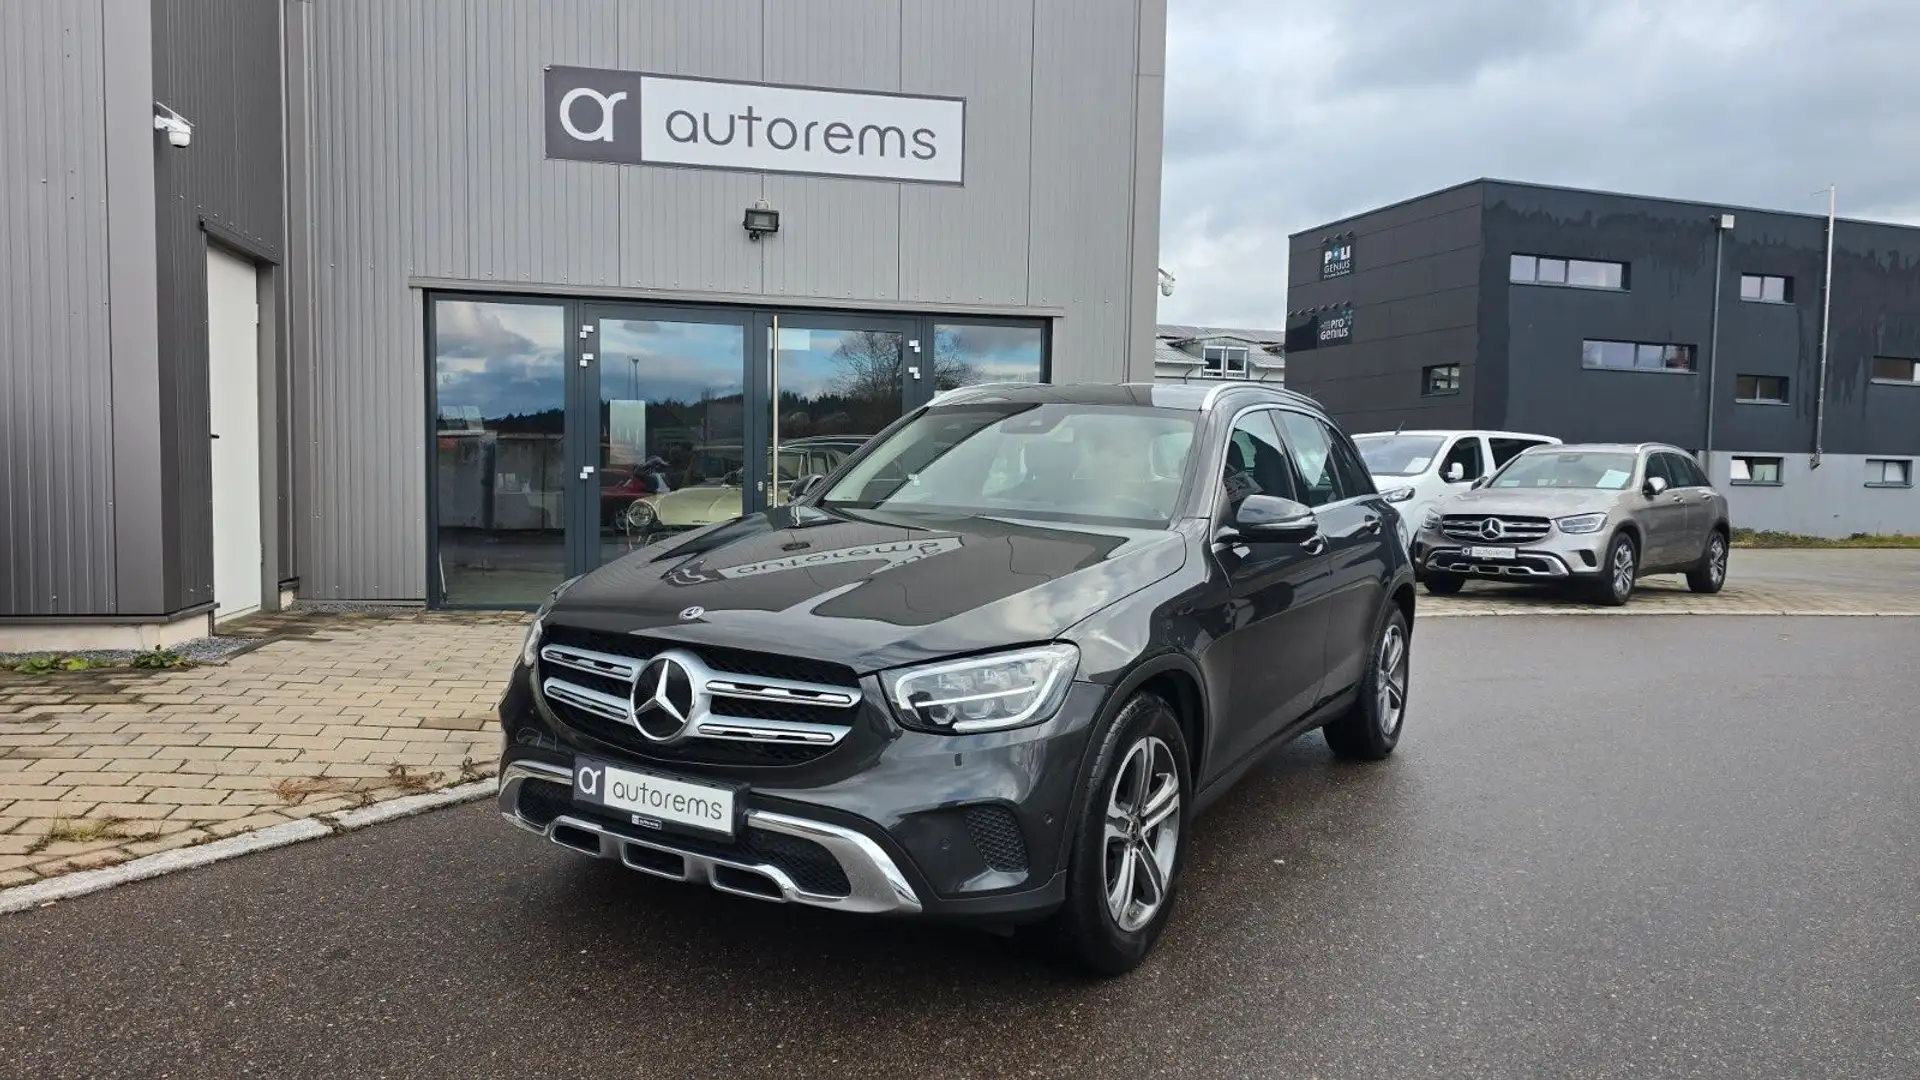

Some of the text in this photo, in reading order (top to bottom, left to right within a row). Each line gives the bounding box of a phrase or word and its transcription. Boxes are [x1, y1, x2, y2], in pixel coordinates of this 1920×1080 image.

[665, 105, 938, 161] autorems
[1323, 260, 1350, 274] GENIUS
[612, 781, 723, 820] autorems
